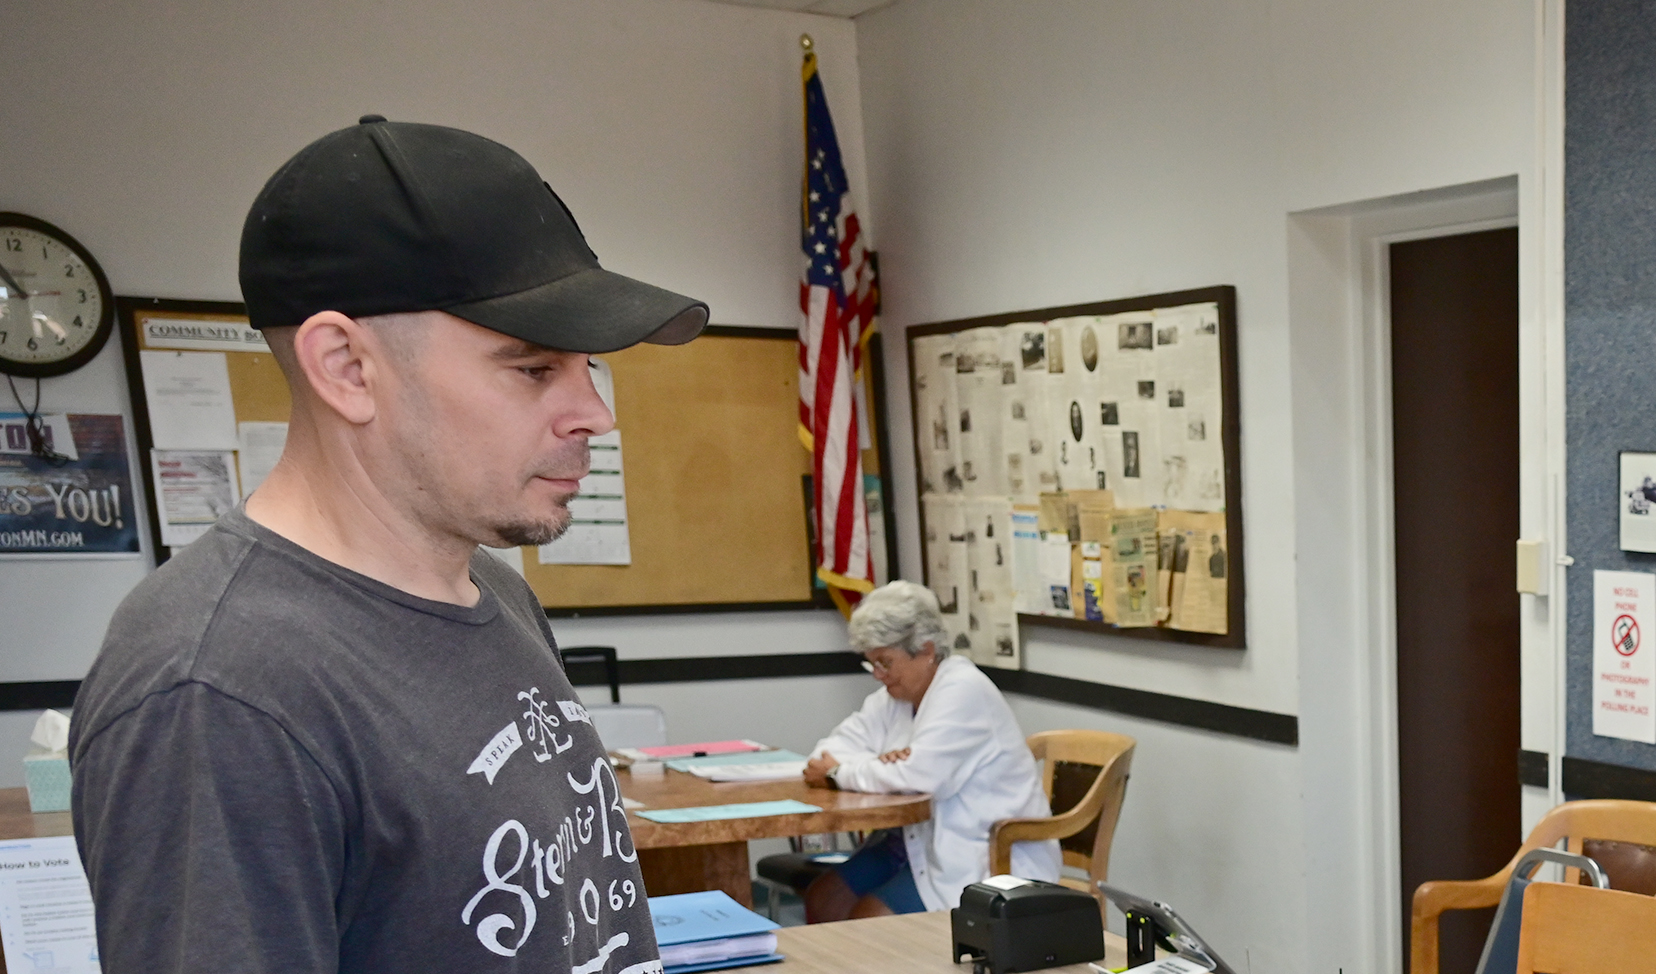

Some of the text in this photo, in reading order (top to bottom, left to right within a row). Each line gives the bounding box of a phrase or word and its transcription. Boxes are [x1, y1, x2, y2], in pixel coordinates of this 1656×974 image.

[64, 264, 74, 278] 2
[77, 289, 87, 304] 3
[149, 324, 241, 341] COMMUNITY
[27, 338, 38, 351] 6
[44, 484, 123, 529] YOU!
[484, 733, 515, 767] SPEAK
[28, 858, 41, 870] to
[44, 857, 70, 868] Vote
